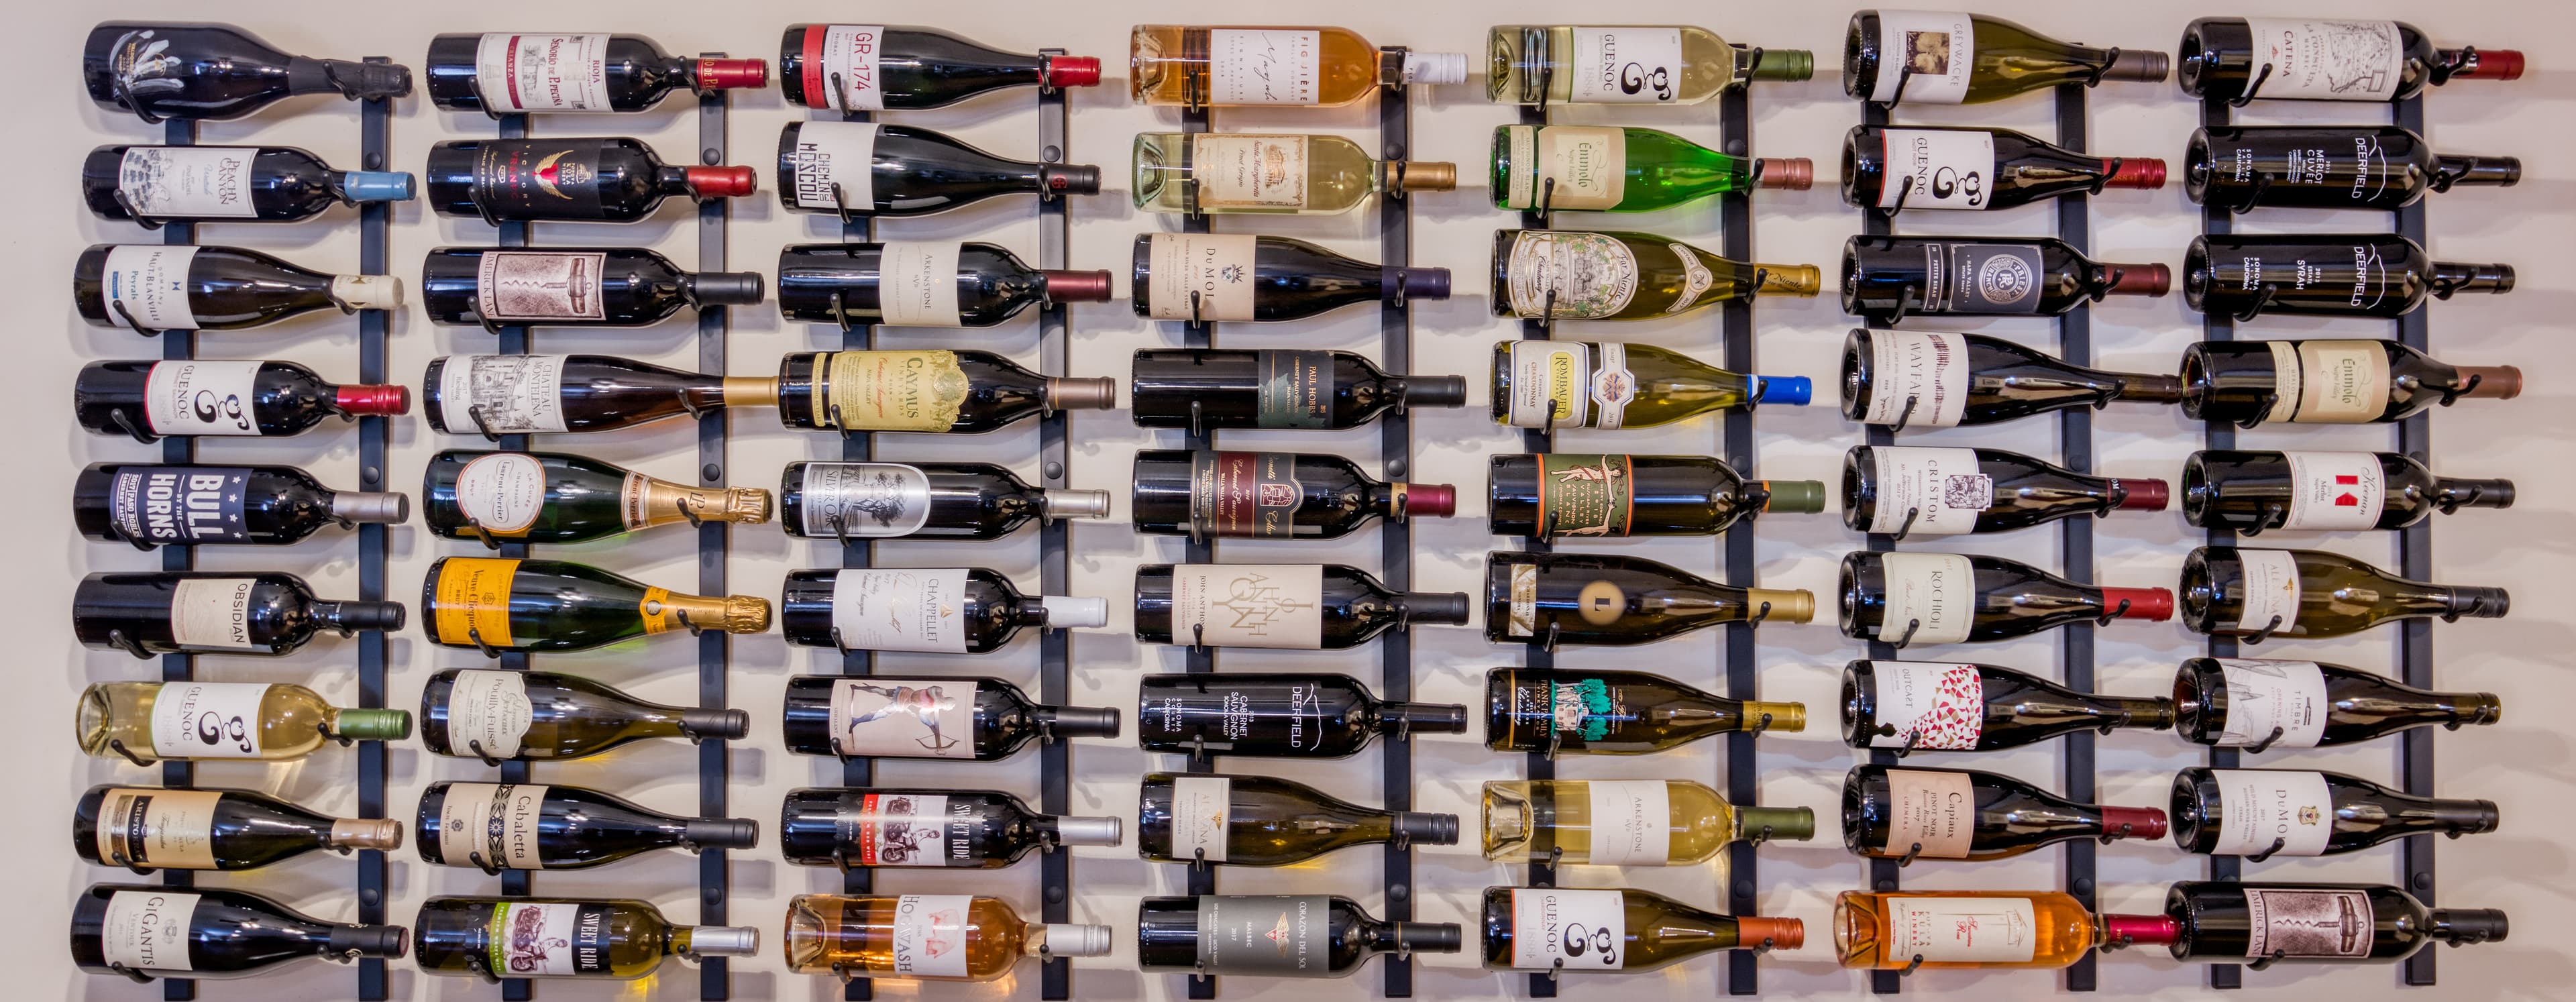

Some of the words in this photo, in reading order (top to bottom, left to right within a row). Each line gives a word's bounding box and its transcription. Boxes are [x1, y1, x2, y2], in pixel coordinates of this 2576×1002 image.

[507, 46, 515, 78] CRIANZA
[548, 38, 565, 65] SEÑORÍO
[548, 67, 555, 75] DE
[592, 60, 601, 83] RIOJA
[853, 32, 873, 91] GR-174
[1254, 32, 1277, 101] Magali
[1604, 34, 1615, 91] GUENOC
[1950, 23, 1964, 86] GREYWACKE
[2282, 31, 2294, 77] CATENA
[549, 85, 563, 106] PECIÑA
[1253, 140, 1263, 158] Santa
[1578, 143, 1592, 187] Emmolo
[1915, 137, 1928, 195] GUENOC
[2305, 150, 2316, 184] CUVÉE
[2314, 150, 2324, 184] MERLOT
[2352, 138, 2367, 198] DEERFIELD
[219, 158, 232, 205] CANYON
[227, 161, 240, 203] PEACHY
[510, 151, 519, 199] VRANEC
[521, 145, 531, 207] VICTORY
[798, 143, 818, 201] MOSCOU
[818, 154, 830, 192] CHEMIN
[1237, 167, 1245, 188] Grigio
[1251, 155, 1263, 197] Margherita
[484, 253, 495, 292] LIMERICK
[1535, 256, 1546, 293] Chardonnay
[1617, 253, 1629, 268] Far
[1986, 268, 1994, 291] RANCH
[2015, 266, 2027, 295] PRIEST
[2296, 260, 2306, 290] SYRAH
[2351, 247, 2366, 306] DEERFIELD
[130, 270, 139, 300] Peyrals
[146, 252, 162, 321] HAUT-BLANVILLE
[923, 255, 933, 309] ARKENSTONE
[1614, 272, 1631, 301] Niente
[484, 295, 494, 317] LANE
[178, 366, 195, 419] GUENOC
[531, 361, 543, 416] MONTELENA
[541, 364, 552, 412] CHATEAU
[906, 357, 923, 418] CAYMUS
[1555, 357, 1568, 414] ROMBAUER
[2342, 359, 2357, 403] Emmolo
[129, 474, 139, 490] 2017
[497, 461, 510, 520] Laurent-Perrier
[824, 471, 839, 501] SILVER
[1232, 459, 1244, 490] Cabernet
[1926, 460, 1939, 522] CRISTOM
[2359, 467, 2375, 516] Keenan
[127, 492, 136, 511] PASO
[147, 474, 177, 538] HORNS
[177, 494, 182, 502] BY
[186, 475, 225, 539] BULL
[824, 504, 838, 527] OAK
[1229, 490, 1242, 530] Sauvignon
[129, 513, 141, 537] ROBLES
[470, 569, 484, 591] Veuve
[1929, 571, 1943, 629] ROCHIOLI
[232, 583, 248, 643] OBSIDIAN
[467, 594, 478, 630] Clicquot
[926, 579, 939, 643] CHAPPELLET
[1595, 596, 1611, 612] L
[1515, 686, 1528, 725] Chardonnay
[1540, 679, 1548, 705] FRANK
[2292, 691, 2302, 731] TIMBRE
[182, 686, 202, 740] GUENOC
[486, 679, 503, 750] Pouilly-Fuissé
[1230, 691, 1238, 740] SAUVIGNON
[1240, 695, 1248, 737] CABERNET
[1291, 687, 1302, 747] DEERFIELD
[1540, 708, 1548, 737] FAMILY
[515, 795, 531, 858] Cabaletta
[953, 805, 971, 836] SWEET
[1634, 797, 1642, 853] ARKENSTONE
[1945, 792, 1962, 838] Capiaux
[2249, 799, 2257, 843] MOUNTAINSIDE
[953, 839, 970, 859] RIDE
[128, 913, 139, 946] VENTOUX
[580, 913, 600, 944] SWEET
[1299, 902, 1307, 938] CORAZON
[1546, 896, 1557, 952] GUENOC
[2250, 890, 2263, 932] LIMERICK
[898, 896, 920, 972] HOGWASH
[1299, 941, 1307, 955] DEL
[2252, 935, 2263, 955] LANE
[580, 948, 598, 968] RIDE
[1299, 958, 1307, 970] SOL
